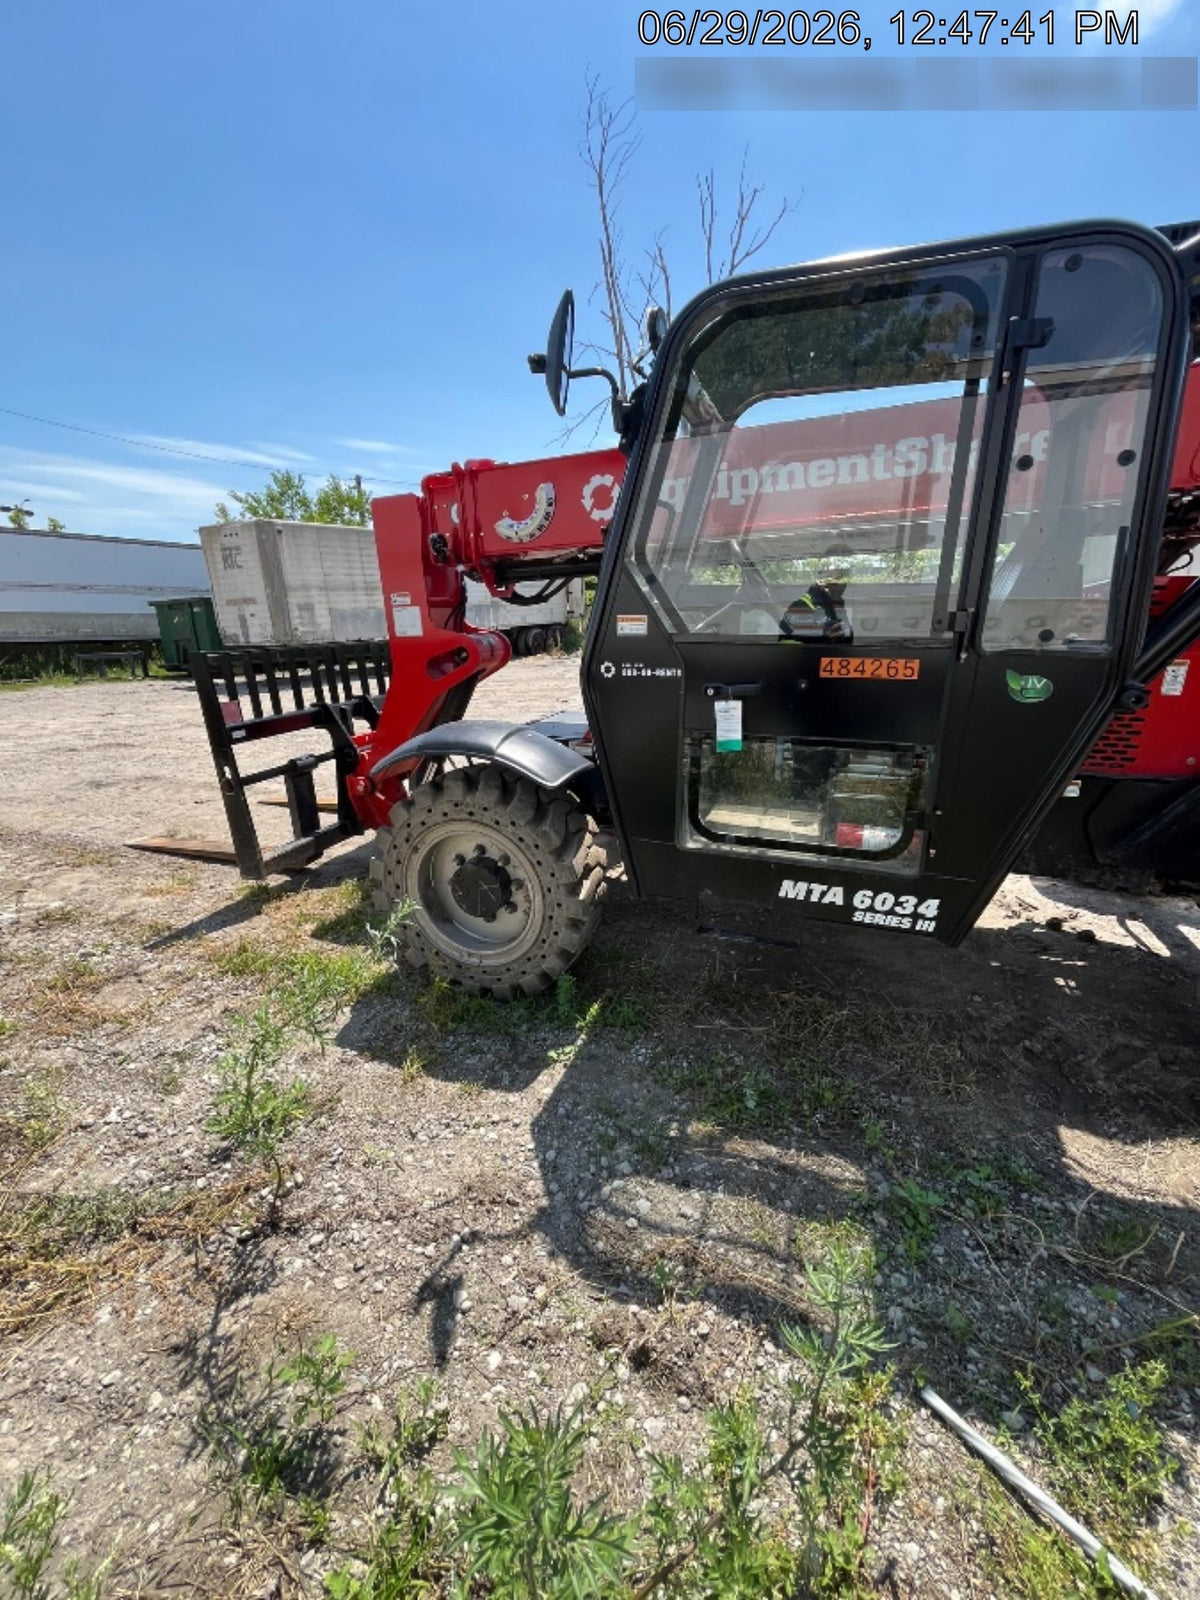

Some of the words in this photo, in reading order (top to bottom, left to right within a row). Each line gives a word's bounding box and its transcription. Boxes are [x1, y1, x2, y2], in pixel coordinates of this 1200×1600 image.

[821, 657, 918, 679] 484265
[778, 879, 844, 906] MTA
[852, 889, 941, 918] 6034
[851, 911, 913, 929] SERIES
